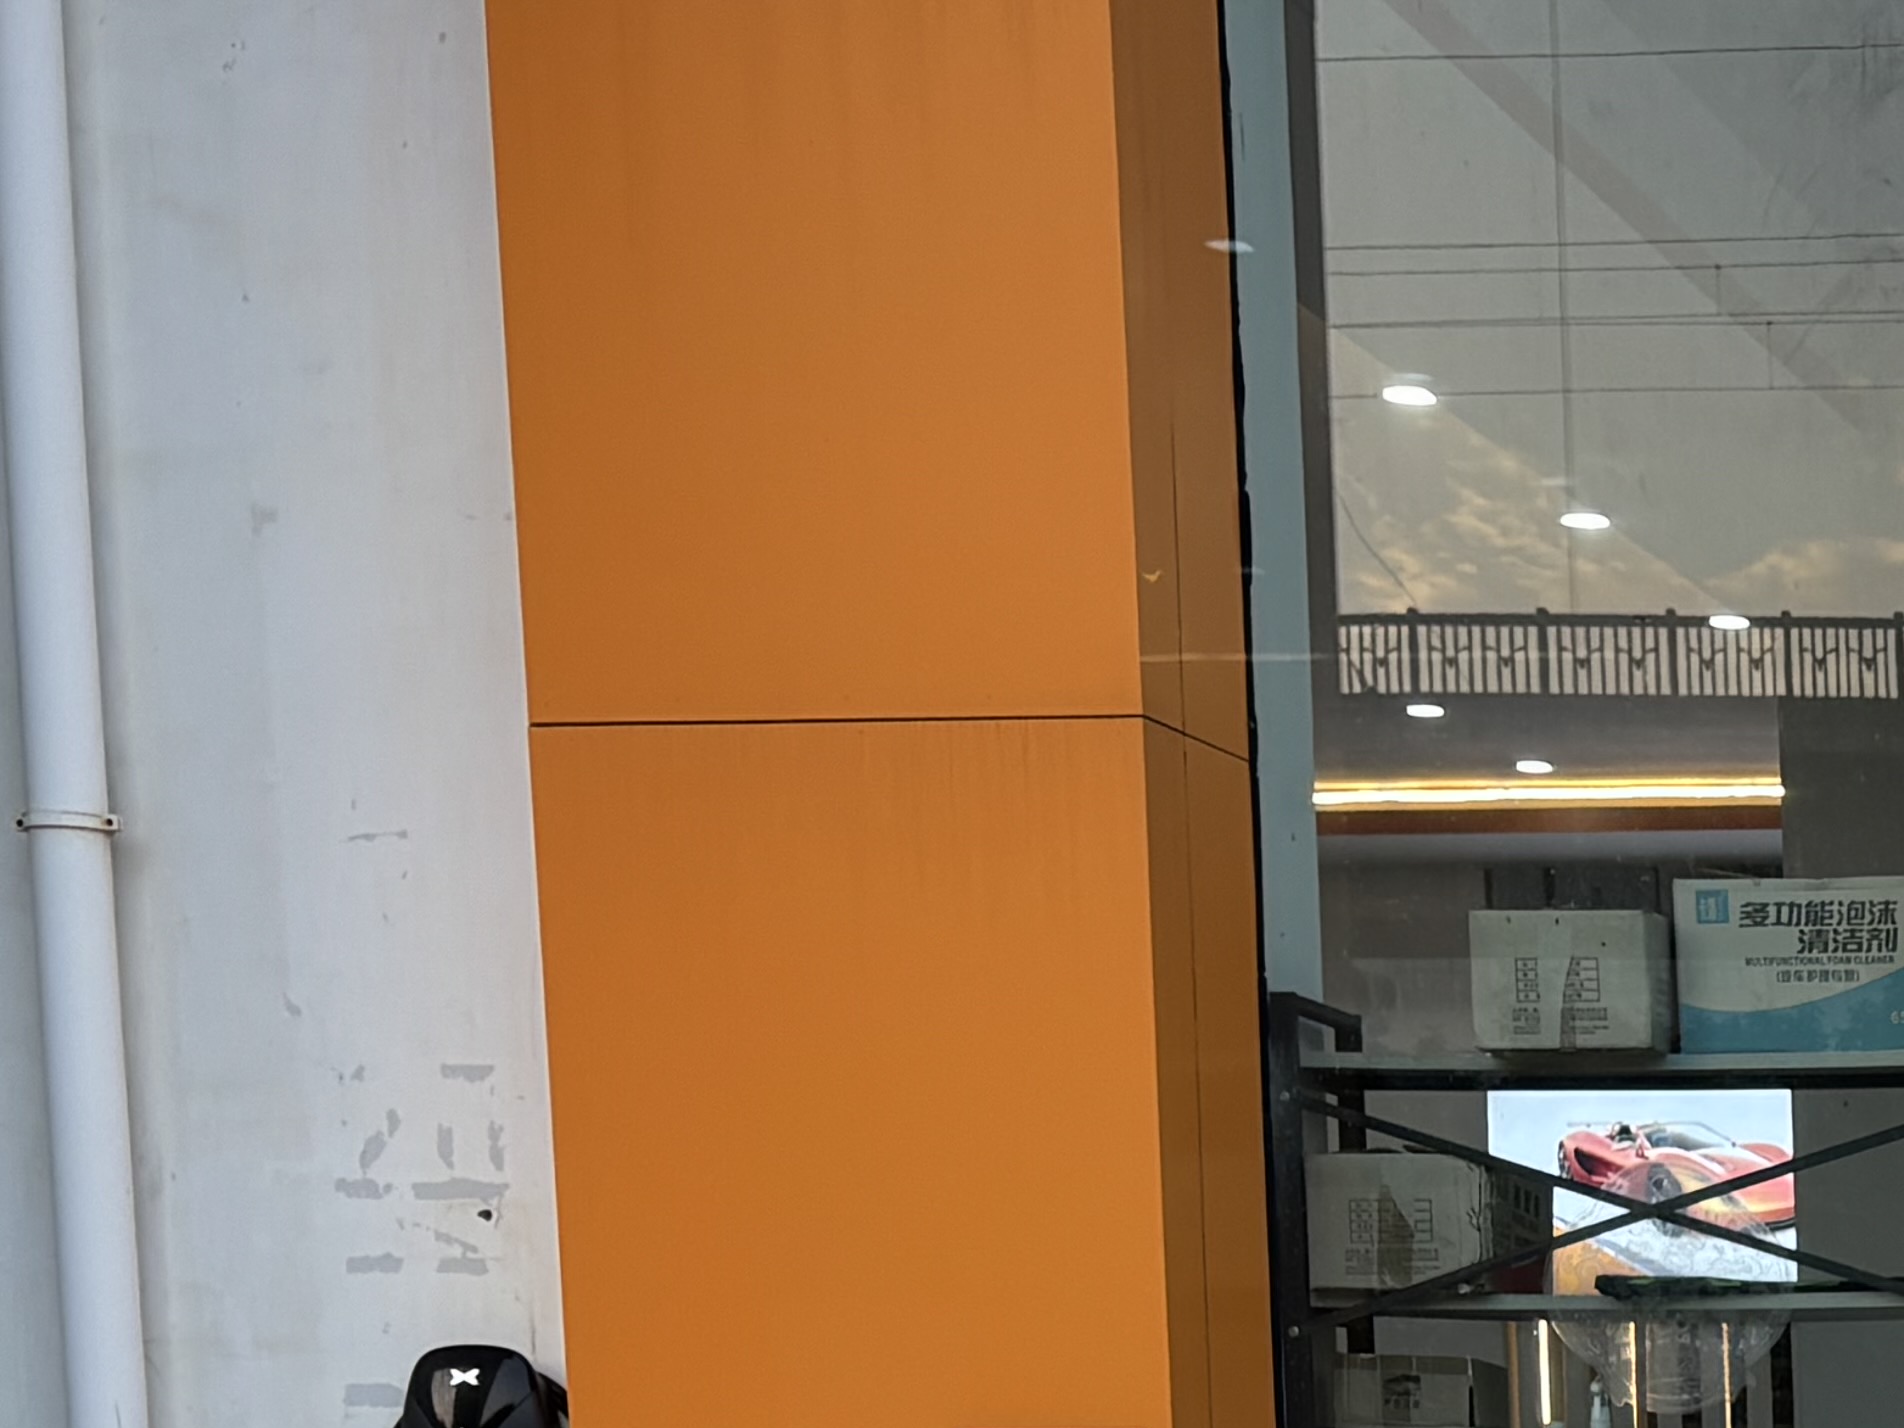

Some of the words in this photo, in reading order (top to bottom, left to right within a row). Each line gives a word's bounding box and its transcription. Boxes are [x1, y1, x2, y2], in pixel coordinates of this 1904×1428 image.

[1738, 900, 1898, 928] 多功能泡沫
[1796, 926, 1898, 954] 清洁剂
